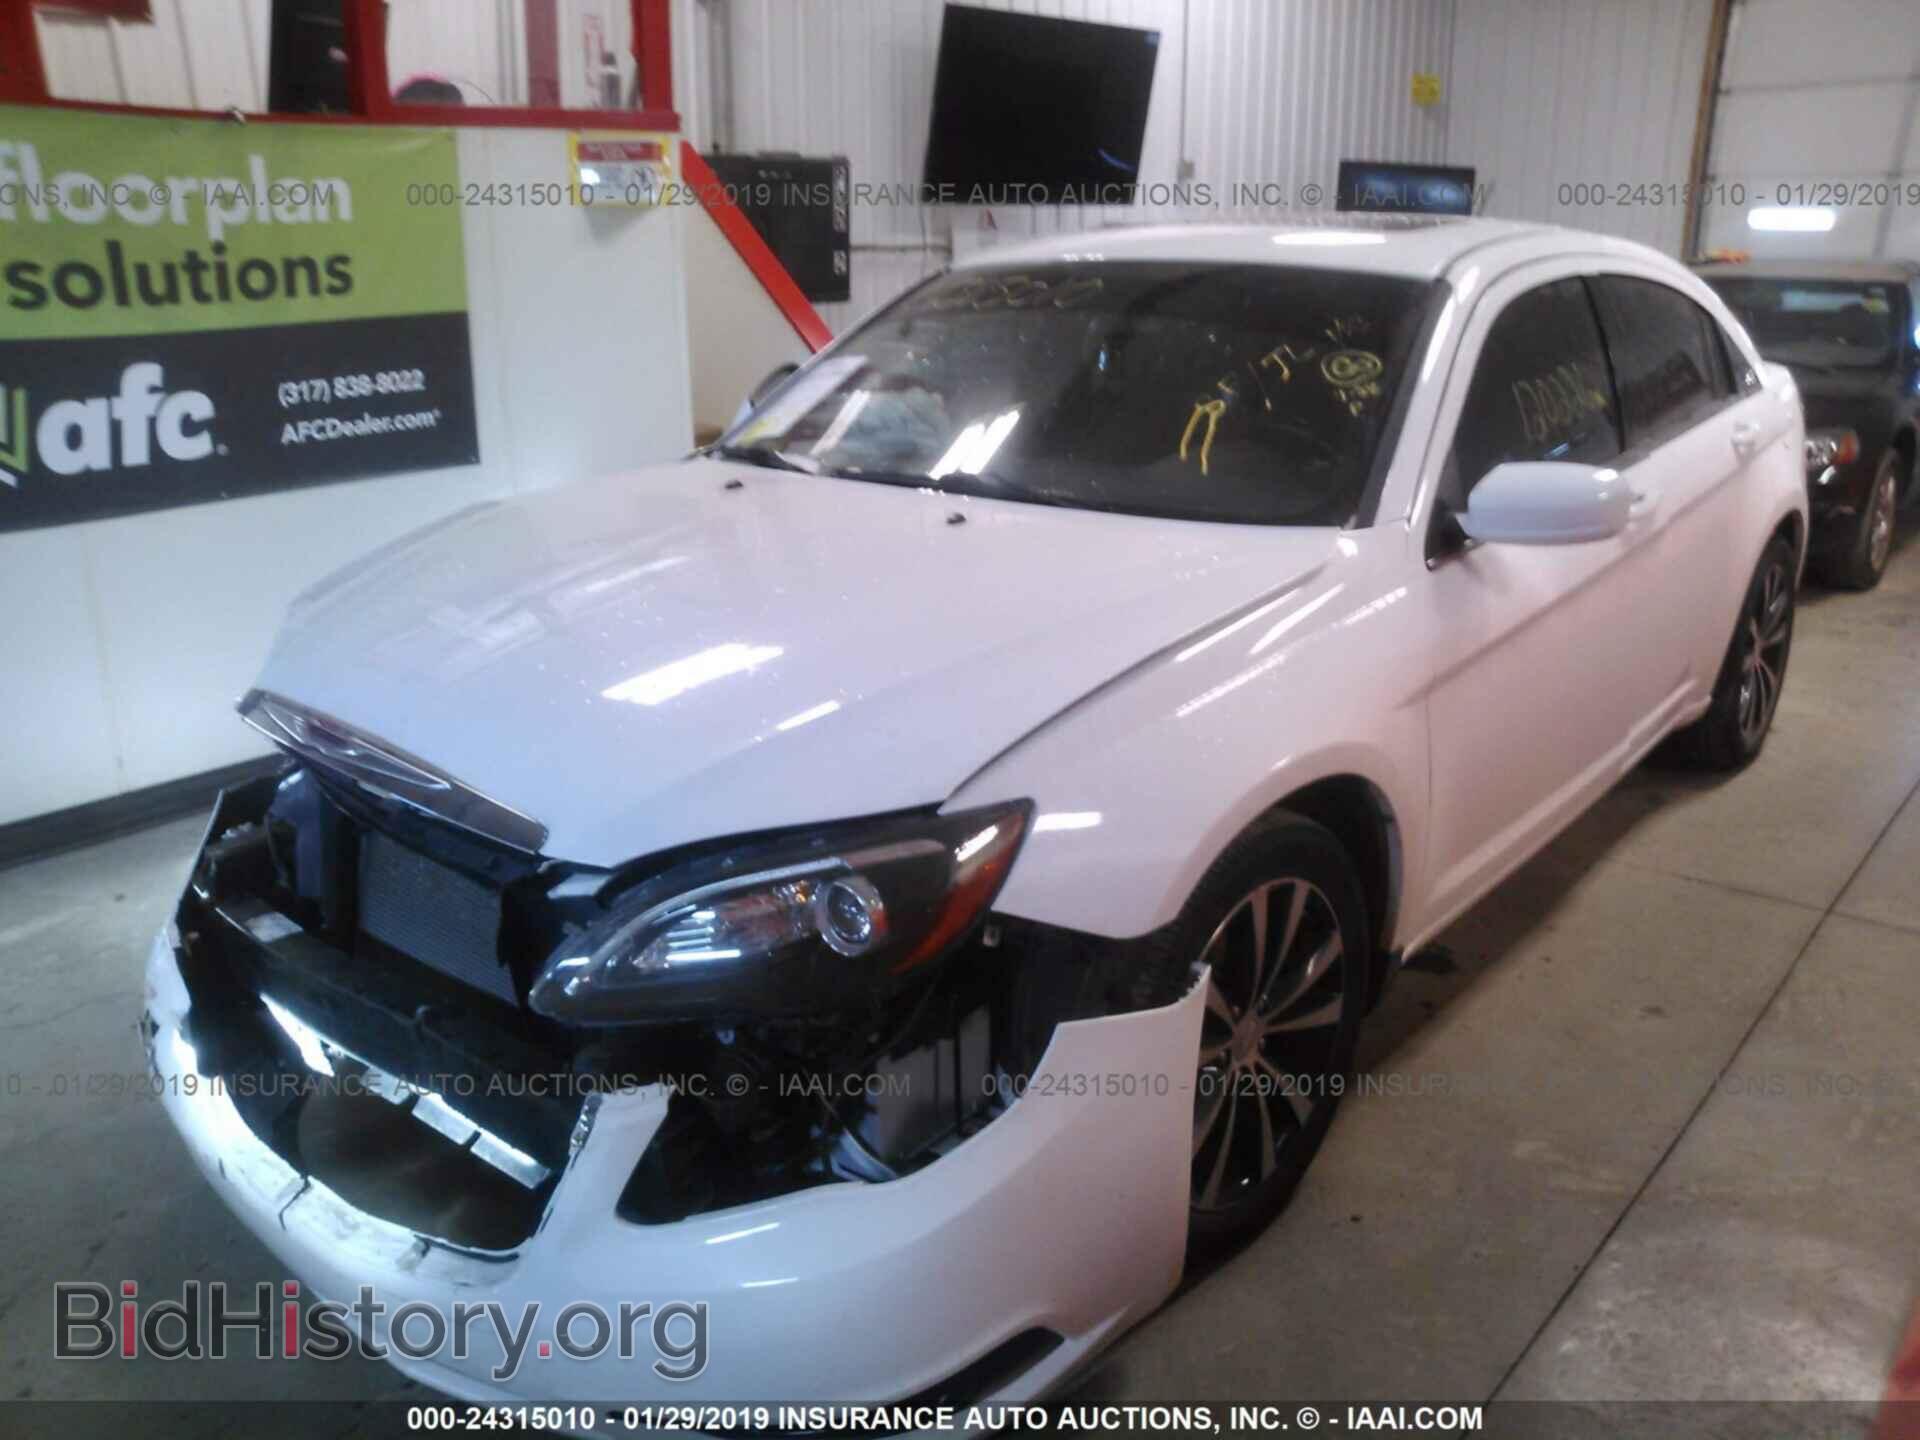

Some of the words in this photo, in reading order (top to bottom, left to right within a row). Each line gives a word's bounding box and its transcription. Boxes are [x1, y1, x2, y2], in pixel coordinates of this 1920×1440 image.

[0, 139, 353, 242] floorplan
[5, 239, 355, 311] solutions
[36, 361, 218, 476] afc
[278, 378, 332, 409] (317)
[333, 368, 427, 400] 838-8022
